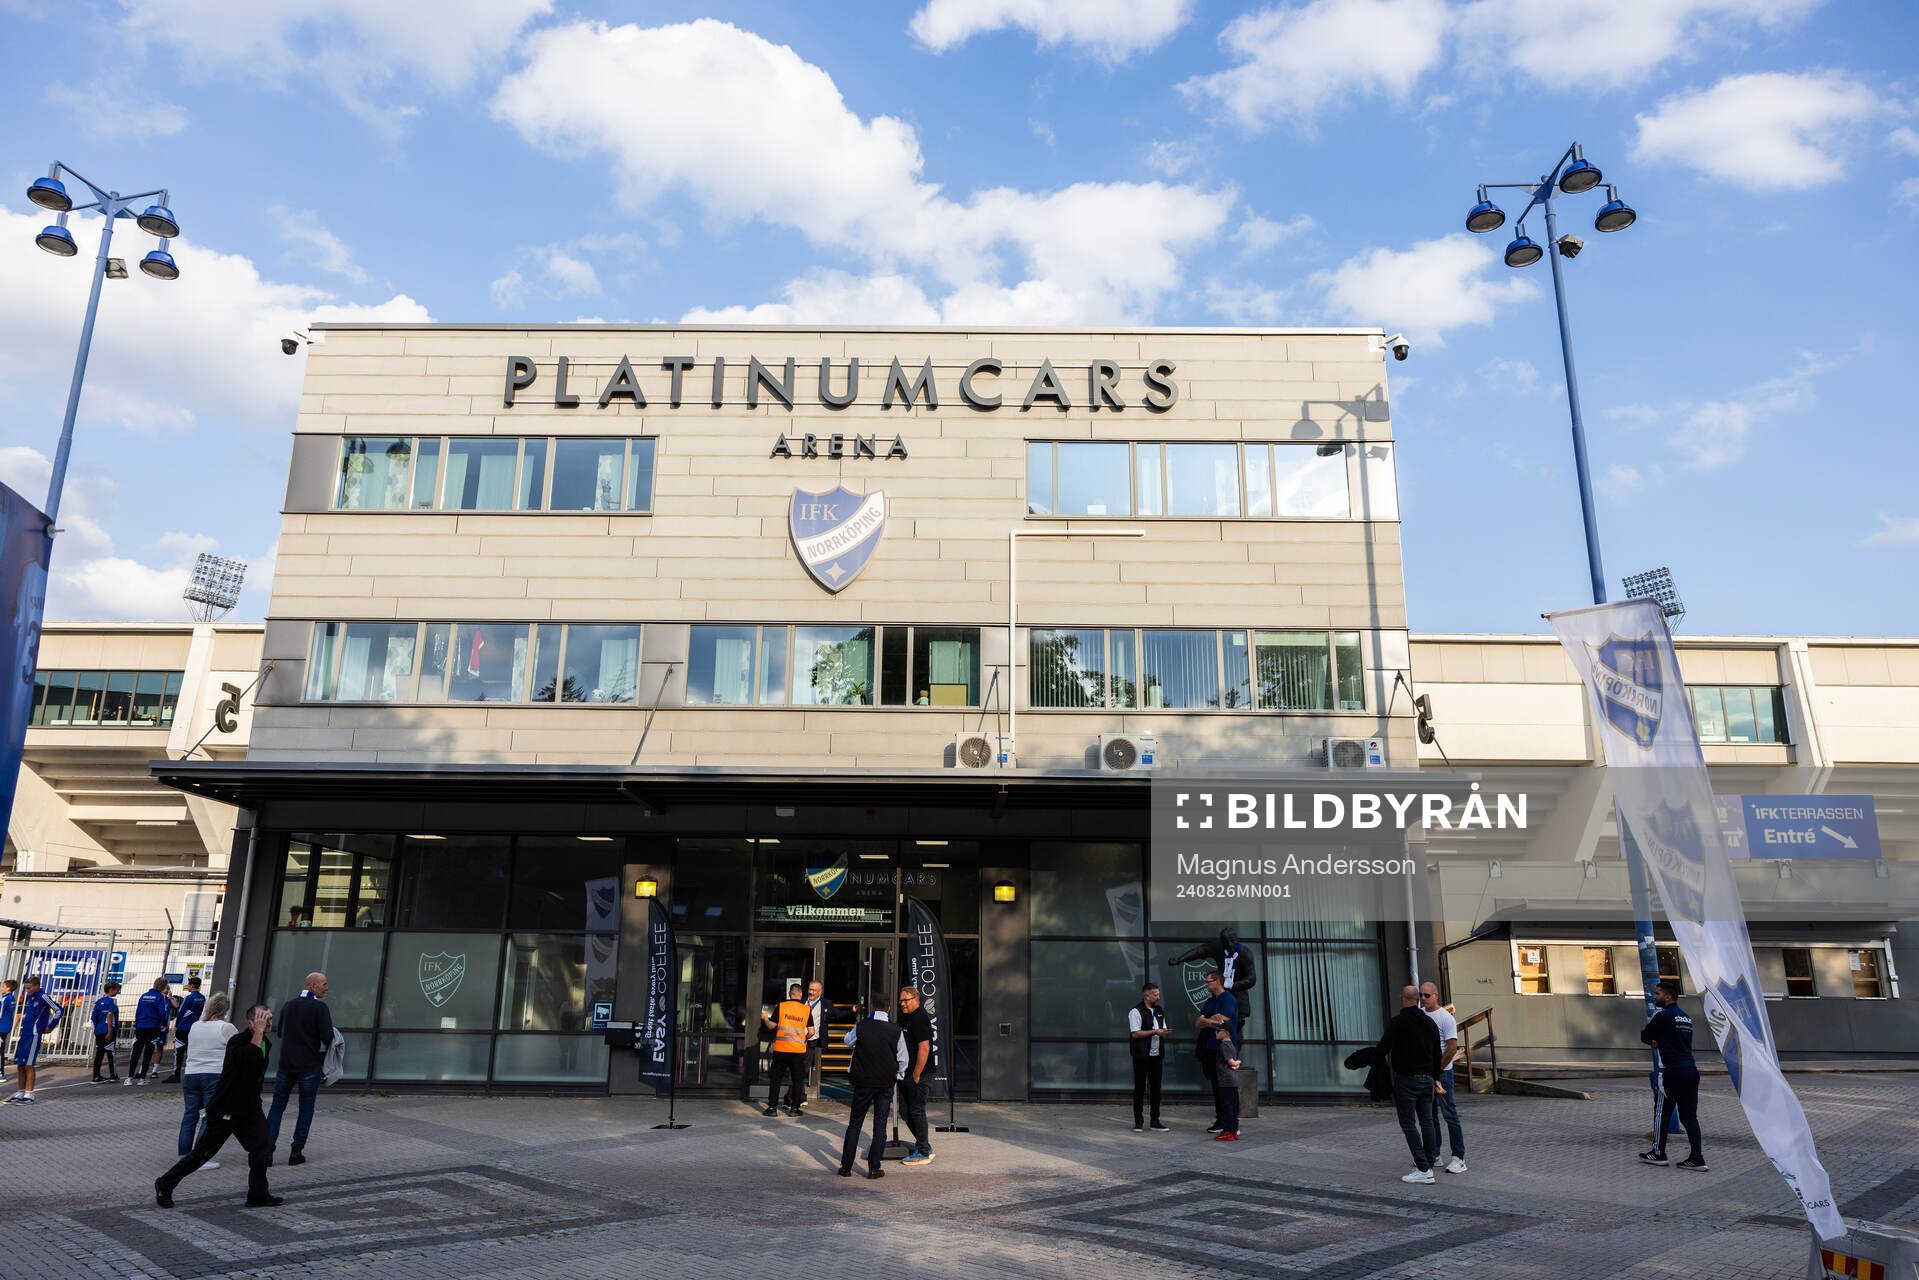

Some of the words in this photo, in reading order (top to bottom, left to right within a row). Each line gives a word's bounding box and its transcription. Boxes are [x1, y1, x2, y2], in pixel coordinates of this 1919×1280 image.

[503, 354, 1179, 412] PLATINUMCARS
[771, 432, 909, 460] ARENA
[800, 503, 839, 521] IFK
[806, 506, 881, 559] NORRKÖPING
[1764, 828, 1817, 844] Entré
[787, 905, 866, 917] Välkommen
[424, 961, 443, 971] IFK
